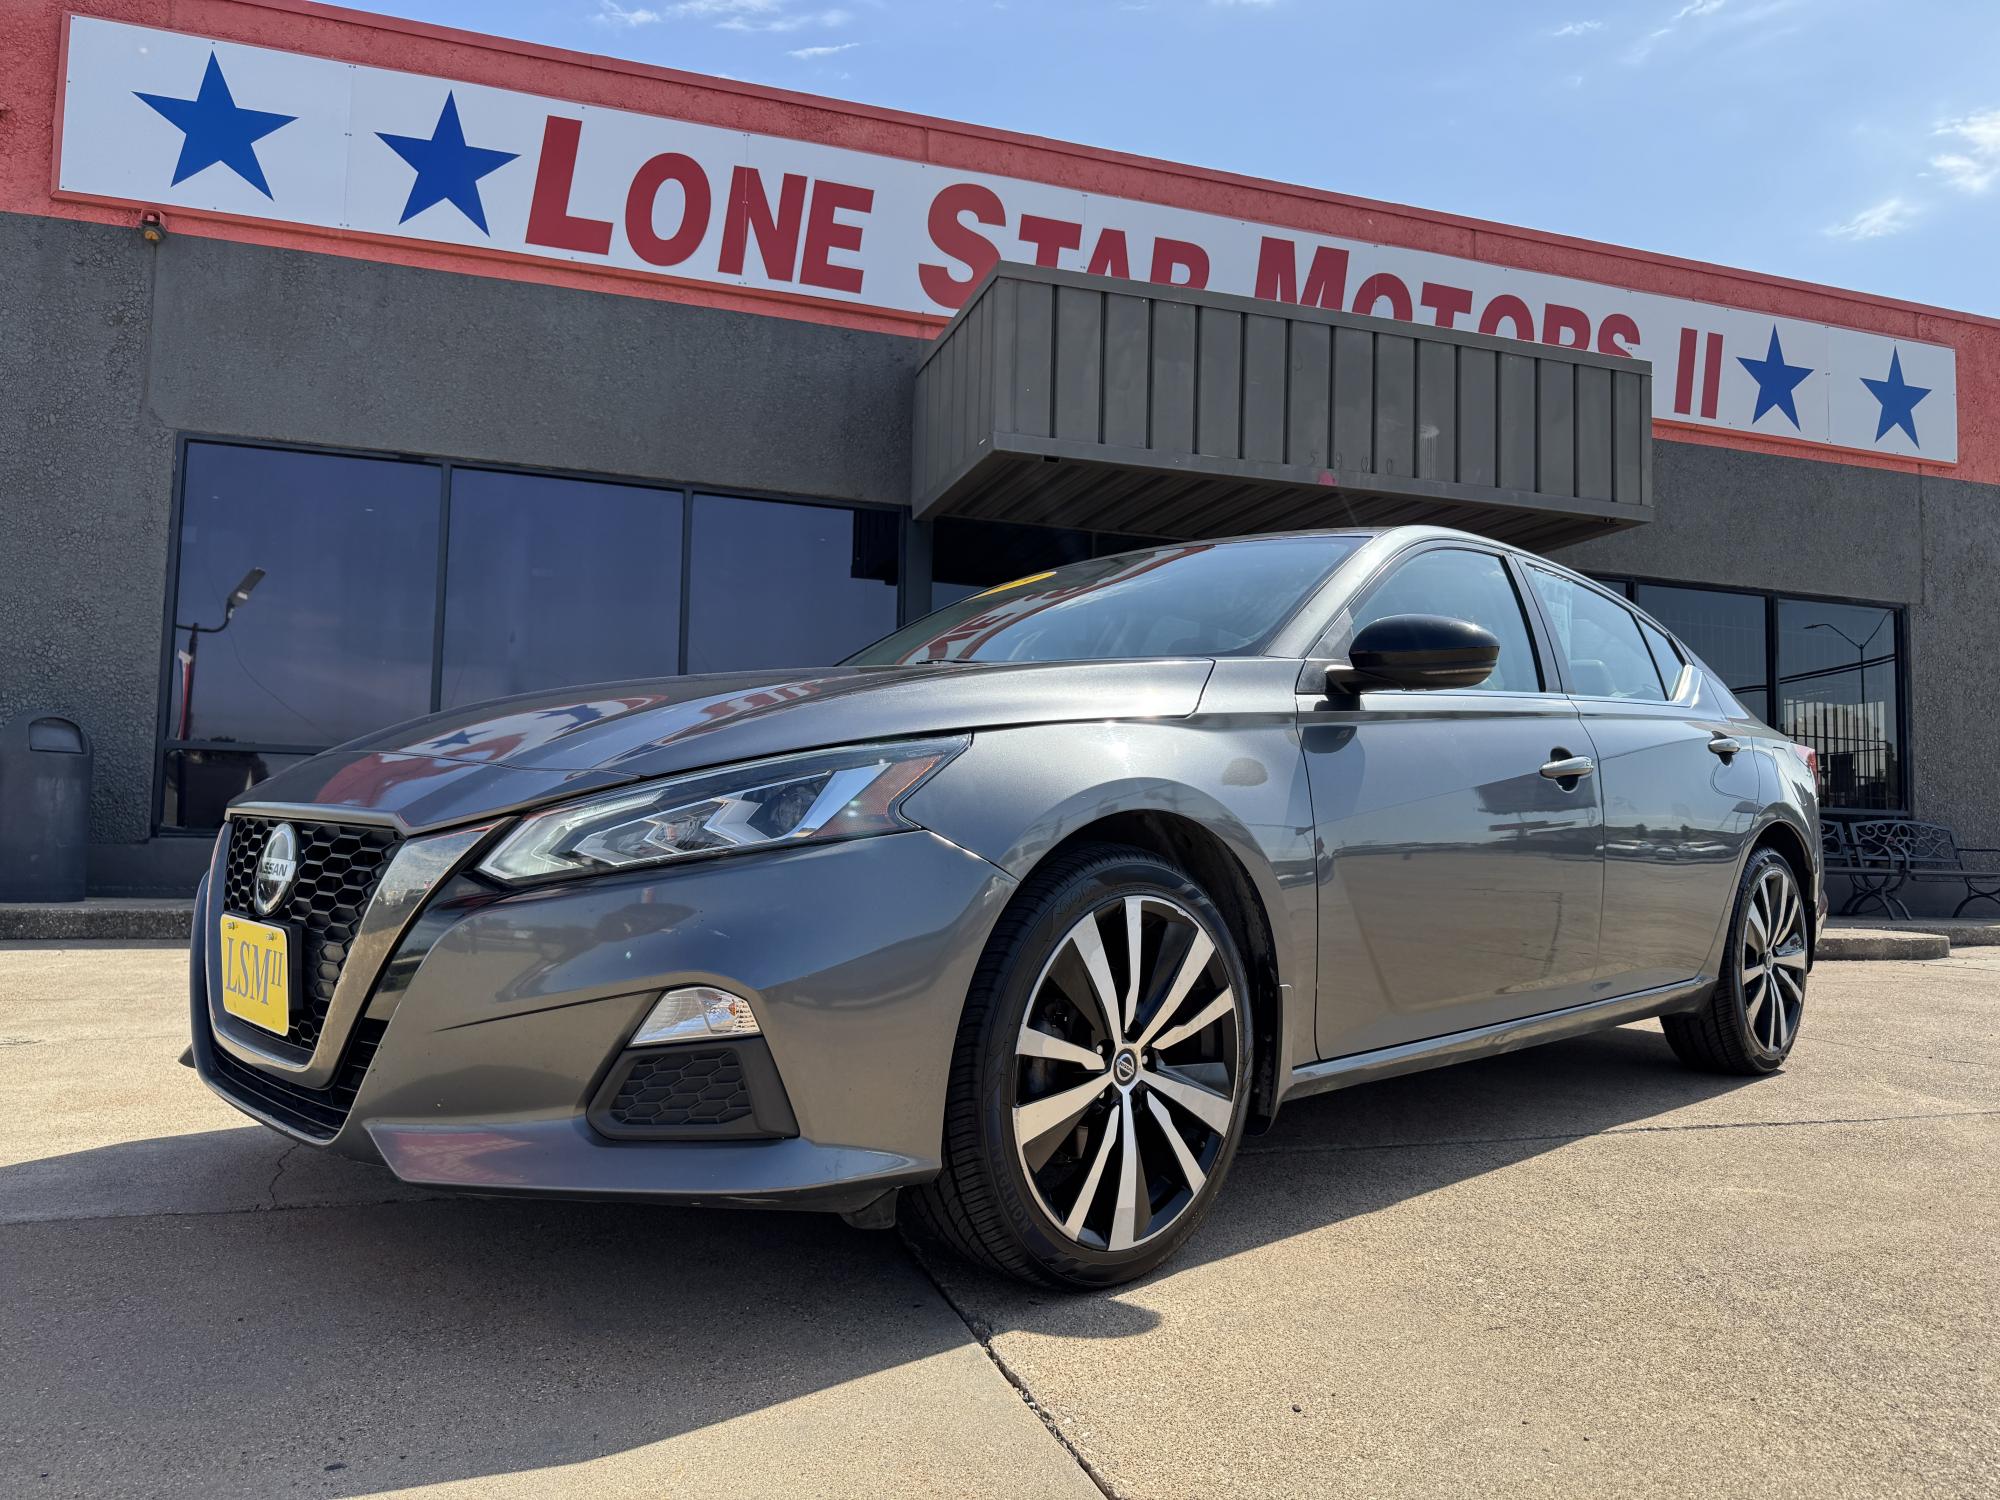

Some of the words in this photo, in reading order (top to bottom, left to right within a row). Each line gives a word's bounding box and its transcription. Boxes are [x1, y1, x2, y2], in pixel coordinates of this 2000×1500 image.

[525, 115, 875, 294] LONE
[1673, 327, 1724, 420] II
[259, 861, 288, 877] SSAN
